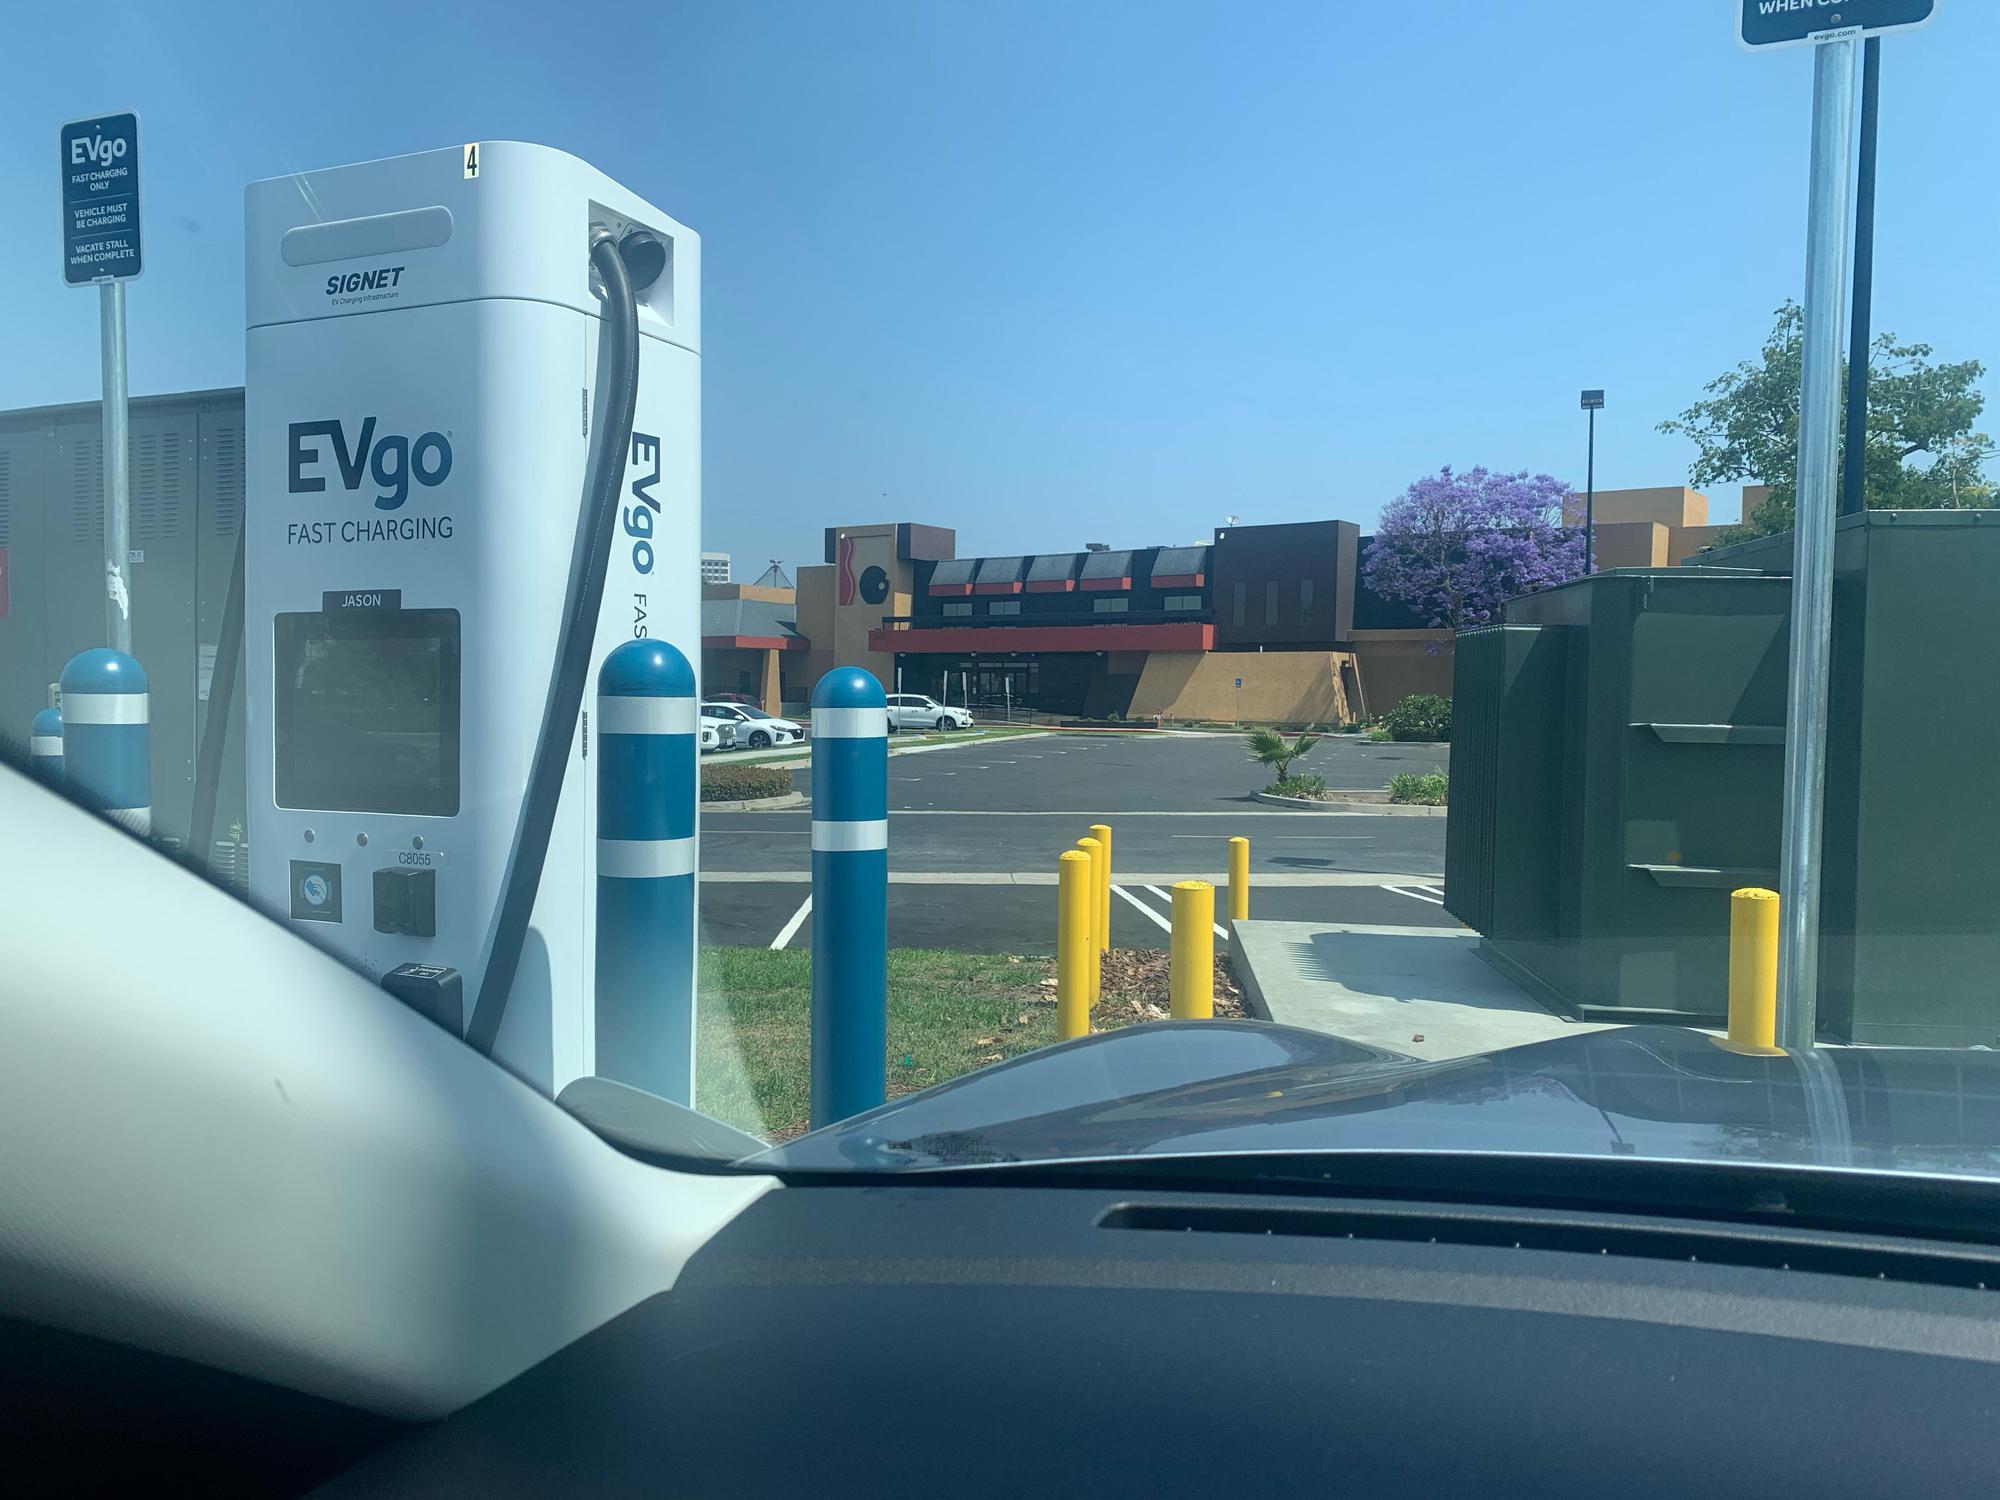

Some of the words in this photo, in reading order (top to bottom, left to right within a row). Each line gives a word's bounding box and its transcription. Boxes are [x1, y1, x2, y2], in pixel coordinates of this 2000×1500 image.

[1760, 0, 1812, 14] WHEN
[1814, 28, 1856, 41] evgo.com
[71, 135, 127, 167] EVgo
[466, 145, 477, 176] 4
[72, 173, 90, 183] FAST
[90, 167, 128, 180] CHARGING
[90, 181, 110, 191] ONLY
[74, 206, 106, 219] VEHICLE
[106, 203, 128, 214] MUST
[76, 219, 86, 229] BE
[86, 214, 127, 227] CHARGING
[75, 242, 104, 254] VACATE
[105, 239, 129, 250] STALL
[70, 254, 93, 265] WHEN
[94, 248, 135, 262] COMPLETE
[325, 266, 406, 295] SIGNET
[288, 416, 453, 511] EVgo
[623, 431, 661, 575] EVgo
[288, 522, 336, 545] FAST
[341, 516, 453, 543] CHARGING
[342, 594, 381, 607] JASON
[633, 593, 648, 639] FAS
[398, 852, 431, 866] C8055
